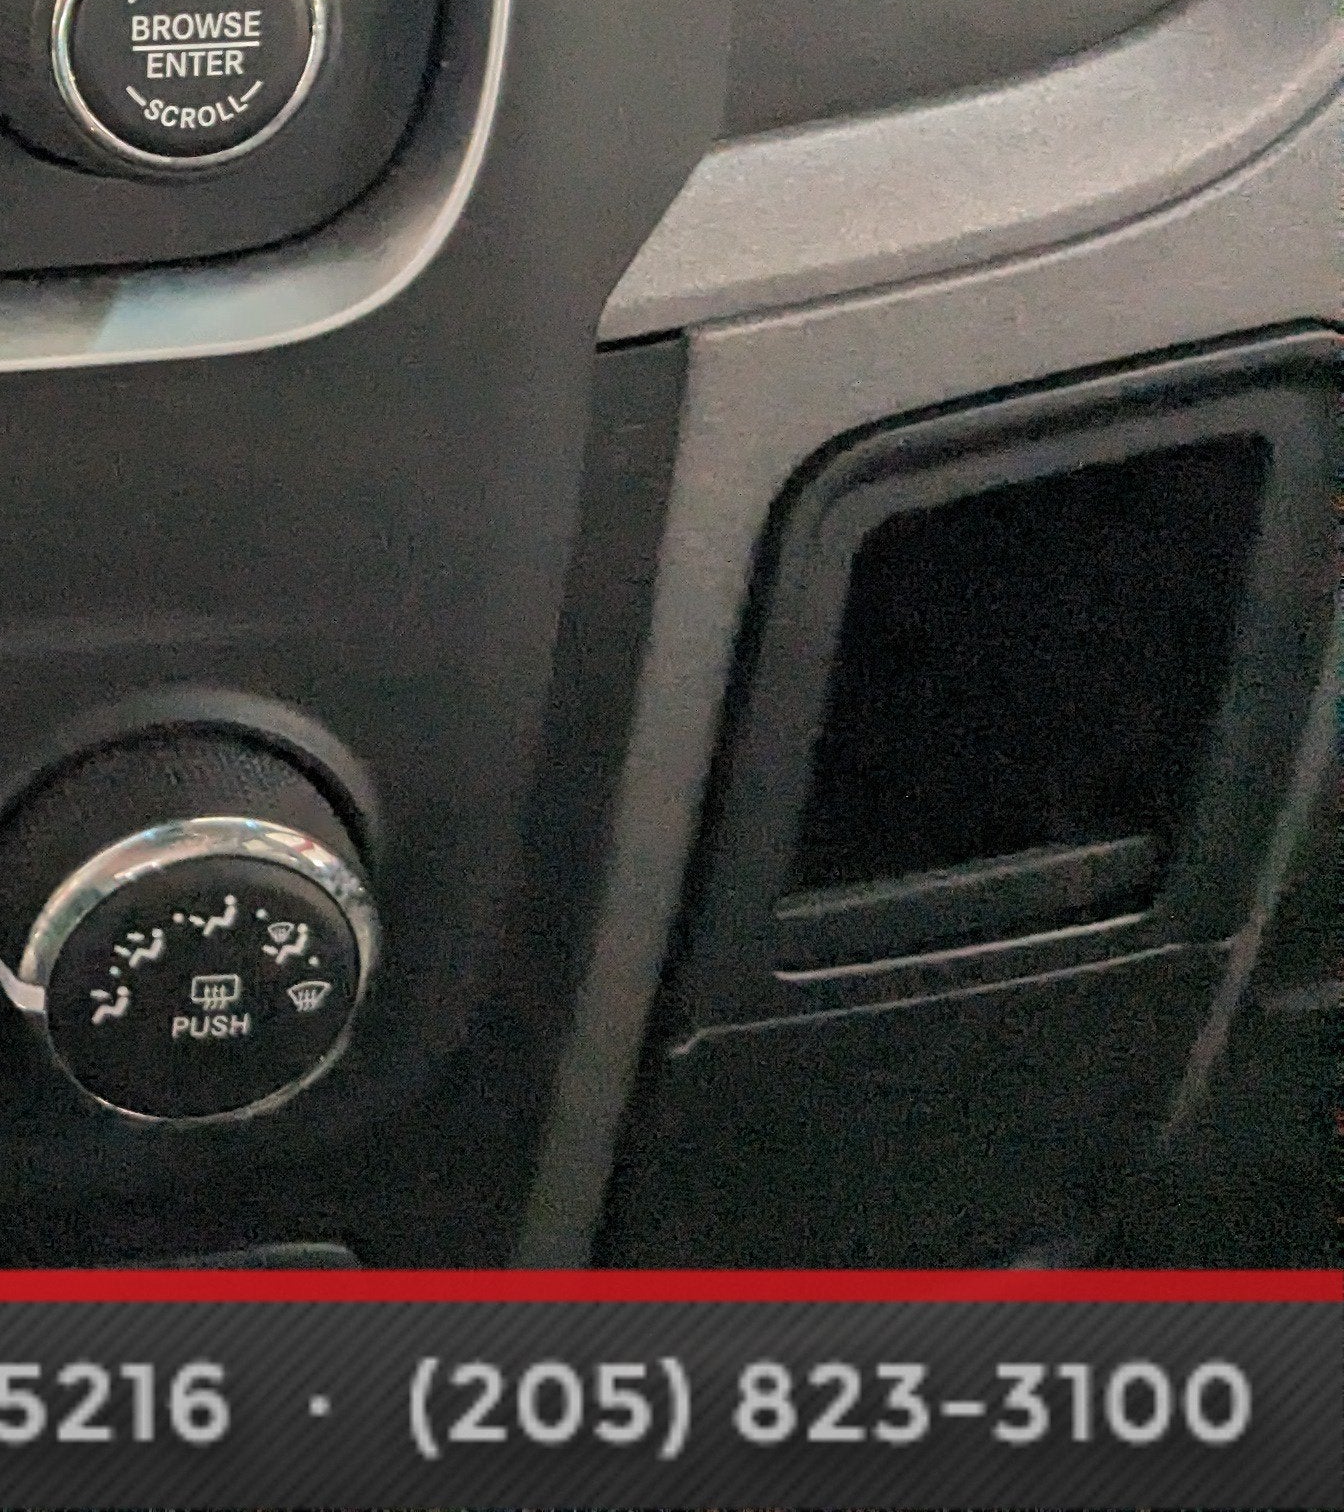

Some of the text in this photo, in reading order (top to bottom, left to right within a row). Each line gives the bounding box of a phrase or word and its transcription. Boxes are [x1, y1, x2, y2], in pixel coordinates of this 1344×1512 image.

[130, 9, 262, 42] BROWSE
[146, 48, 245, 80] ENTER
[143, 94, 249, 131] SCROLL
[171, 1013, 252, 1039] PUSH
